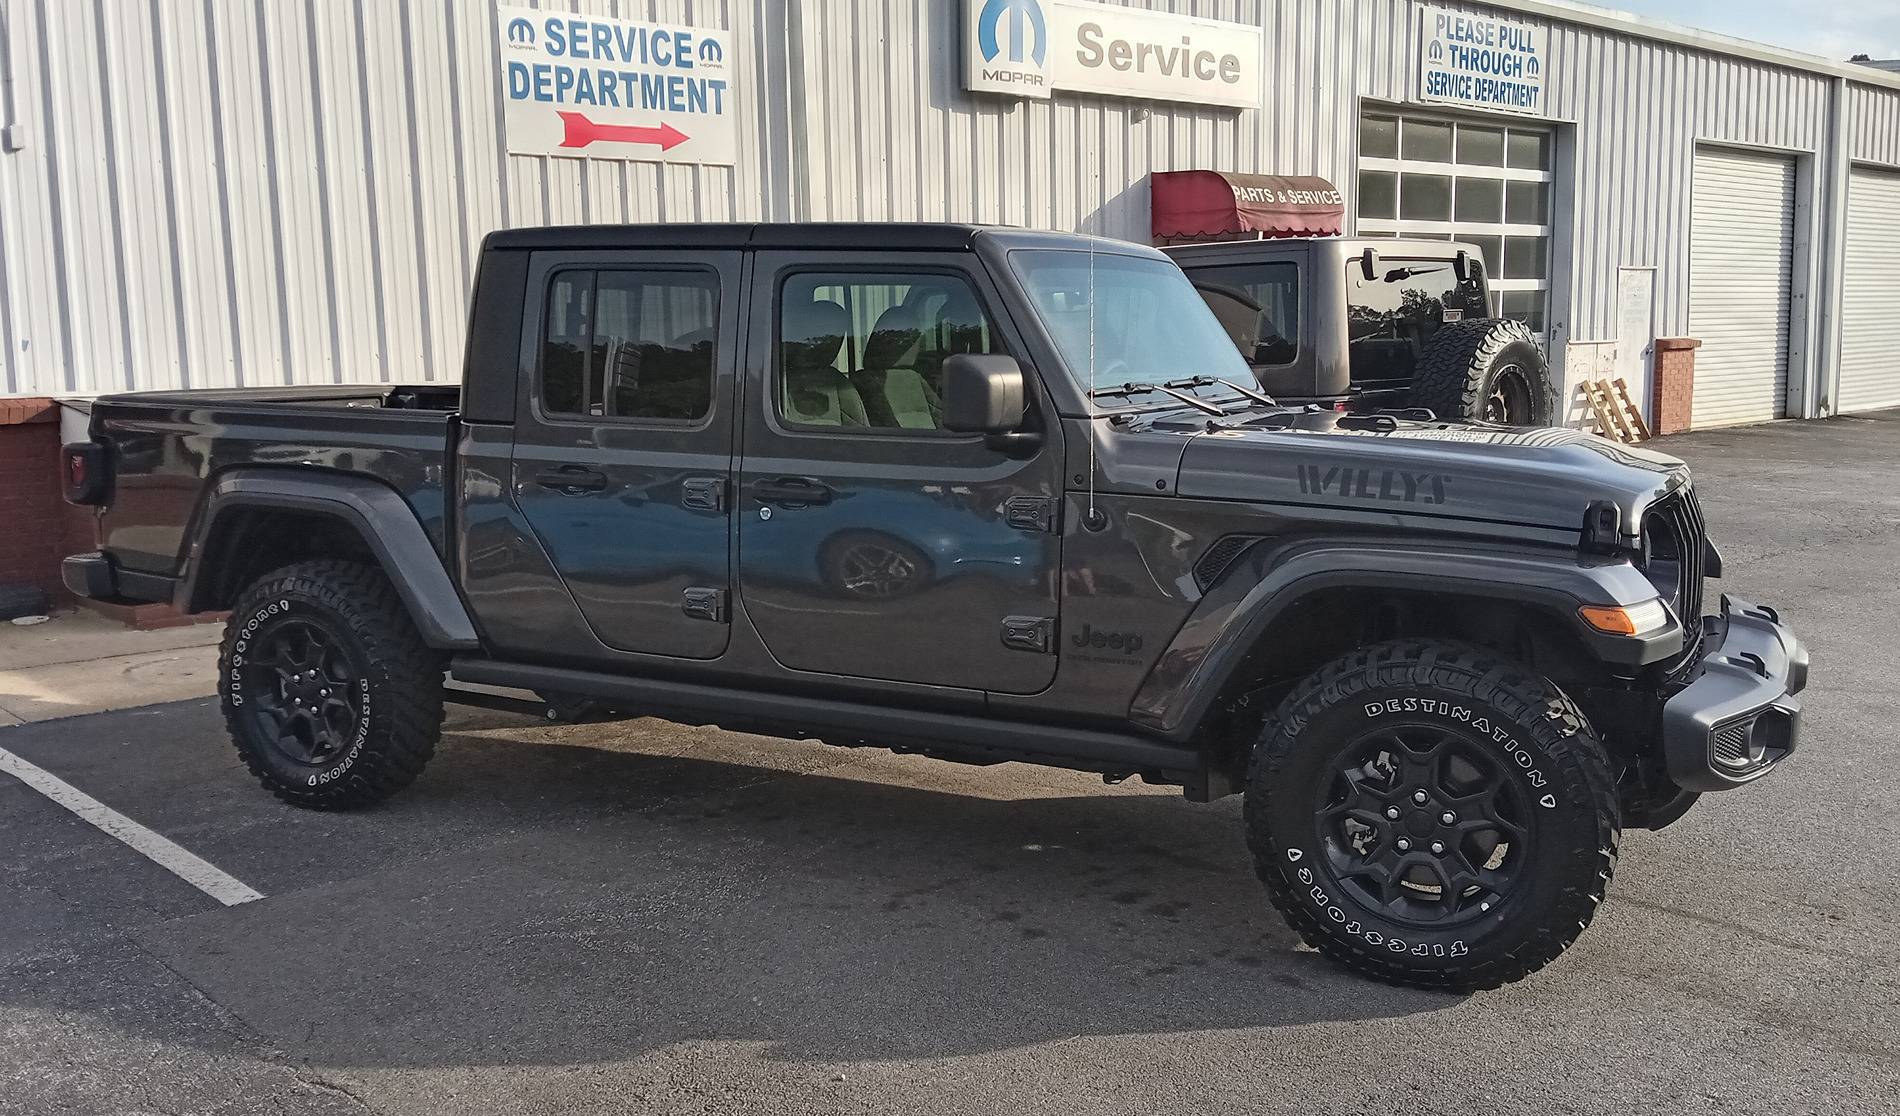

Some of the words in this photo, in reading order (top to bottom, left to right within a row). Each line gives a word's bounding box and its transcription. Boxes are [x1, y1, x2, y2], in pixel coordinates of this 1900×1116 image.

[544, 17, 694, 69] SERVICE
[1076, 21, 1241, 84] Service
[1435, 13, 1495, 47] PLEASE
[1499, 25, 1535, 54] PULL
[982, 68, 1043, 87] MOPAR
[1449, 44, 1523, 79] THROUGH
[508, 60, 727, 115] DEPARTMENT
[1427, 70, 1472, 100] SERVICE
[1474, 77, 1539, 109] DEPARTMENT
[1232, 185, 1275, 204] PARTS
[1278, 190, 1287, 204] &
[1287, 189, 1342, 205] SERVICE
[1297, 464, 1452, 505] WILLYS
[1071, 623, 1143, 655] Jeep
[319, 678, 371, 785] DESTINATION
[1364, 697, 1547, 789] DESTINATION
